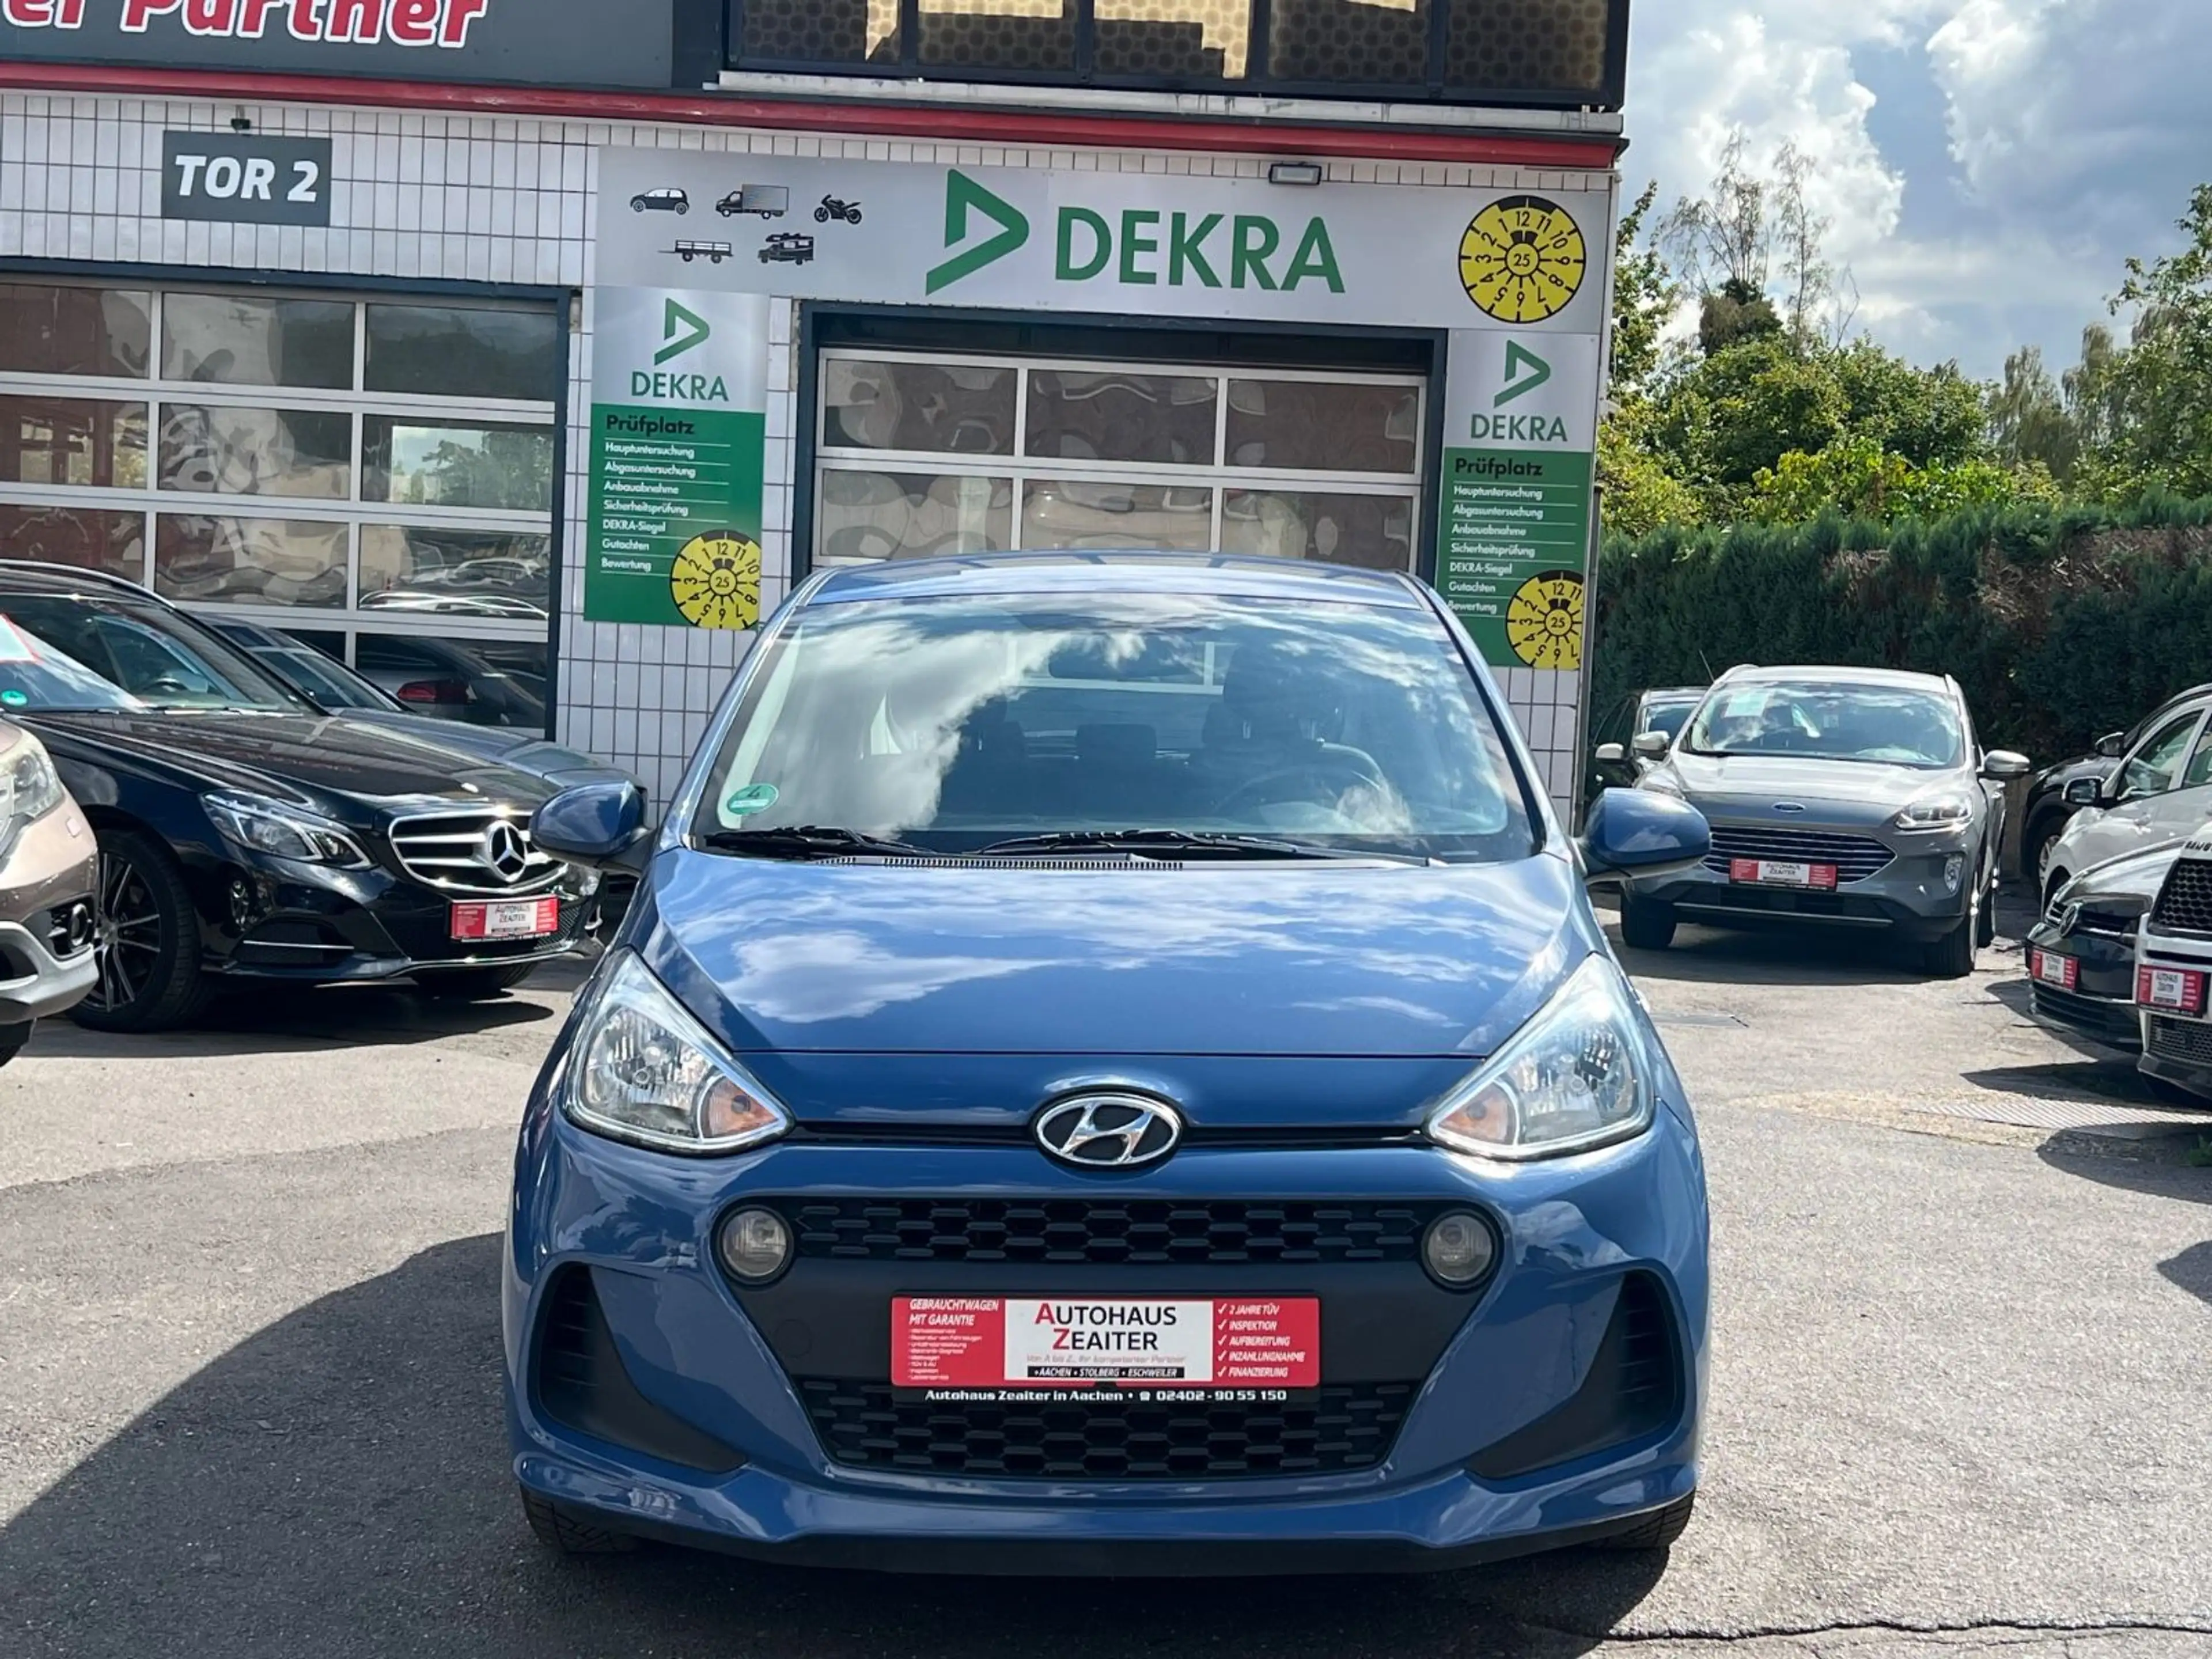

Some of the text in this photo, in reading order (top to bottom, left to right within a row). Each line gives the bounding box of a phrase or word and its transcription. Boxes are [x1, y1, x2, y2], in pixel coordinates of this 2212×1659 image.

[175, 154, 319, 202] TOR 2
[1498, 218, 1508, 233] 1
[1516, 211, 1530, 227] 12
[1537, 215, 1552, 233] 11
[1481, 232, 1497, 246] 2
[1550, 231, 1568, 249] 10
[1055, 206, 1346, 293] DEKRA
[1475, 255, 1491, 263] 3
[1513, 253, 1530, 267] 25
[1554, 256, 1570, 265] 9
[1480, 273, 1494, 282] 4
[1549, 274, 1564, 287] 8
[1494, 287, 1508, 302] 5
[1517, 291, 1524, 308] 6
[1537, 286, 1547, 302] 7
[631, 371, 729, 402] DEKRA
[607, 414, 695, 437] Prüfplatz
[1471, 414, 1568, 442] DEKRA
[605, 442, 695, 459] Hauptuntersuchung
[605, 461, 696, 479] Abgasuntersuchung
[1455, 457, 1543, 479] Prüfplatz
[604, 480, 679, 494] Anbauabnahme
[1454, 485, 1543, 501] Hauptuntersuchung
[604, 499, 688, 517] Sicherheitsprüfung
[1453, 503, 1543, 520] Abgasuntersuchung
[603, 519, 666, 535] DEKRA-Siegel
[1452, 523, 1527, 536] Anbauabnahme
[602, 539, 649, 551] Gutachten
[717, 542, 728, 555] 12
[1451, 542, 1535, 558] Sicherheitsprüfung
[702, 548, 711, 560] 1
[734, 546, 746, 560] 11
[601, 556, 652, 572] Bewertung
[688, 560, 702, 571] 2
[1450, 562, 1512, 576] DEKRA-Siegel
[684, 577, 698, 585] 3
[715, 577, 729, 588] 25
[1449, 581, 1495, 593] Gutachten
[1538, 589, 1547, 600] 1
[1552, 582, 1565, 596] 12
[1570, 586, 1582, 600] 11
[744, 594, 757, 605] 8
[1524, 600, 1538, 611] 2
[700, 604, 711, 616] 5
[736, 604, 743, 618] 7
[1551, 617, 1565, 628] 25
[1523, 633, 1535, 641] 4
[1535, 644, 1547, 657] 5
[1571, 644, 1578, 657] 7
[748, 786, 761, 798] 4
[910, 1298, 999, 1311] GEBRAUCHTWAGEN
[1235, 1305, 1262, 1315] JAHRE
[909, 1313, 975, 1326] MIT GARANTIE
[1035, 1303, 1177, 1325] AUTOHAUS
[1229, 1320, 1277, 1331] INSPEKTION
[1052, 1328, 1158, 1350] ZEAITER
[1229, 1336, 1290, 1346] AUFBEREITUNG
[1040, 1367, 1177, 1377] AACHEN STOLBERG ESCHWEILER
[925, 1389, 995, 1401] Autohaus
[998, 1390, 1051, 1401] Zeaiter
[1053, 1390, 1067, 1400] in
[1069, 1390, 1123, 1401] Aachen
[1156, 1390, 1205, 1401] 02402
[1237, 1390, 1256, 1401] 55
[1260, 1389, 1287, 1401] 150
